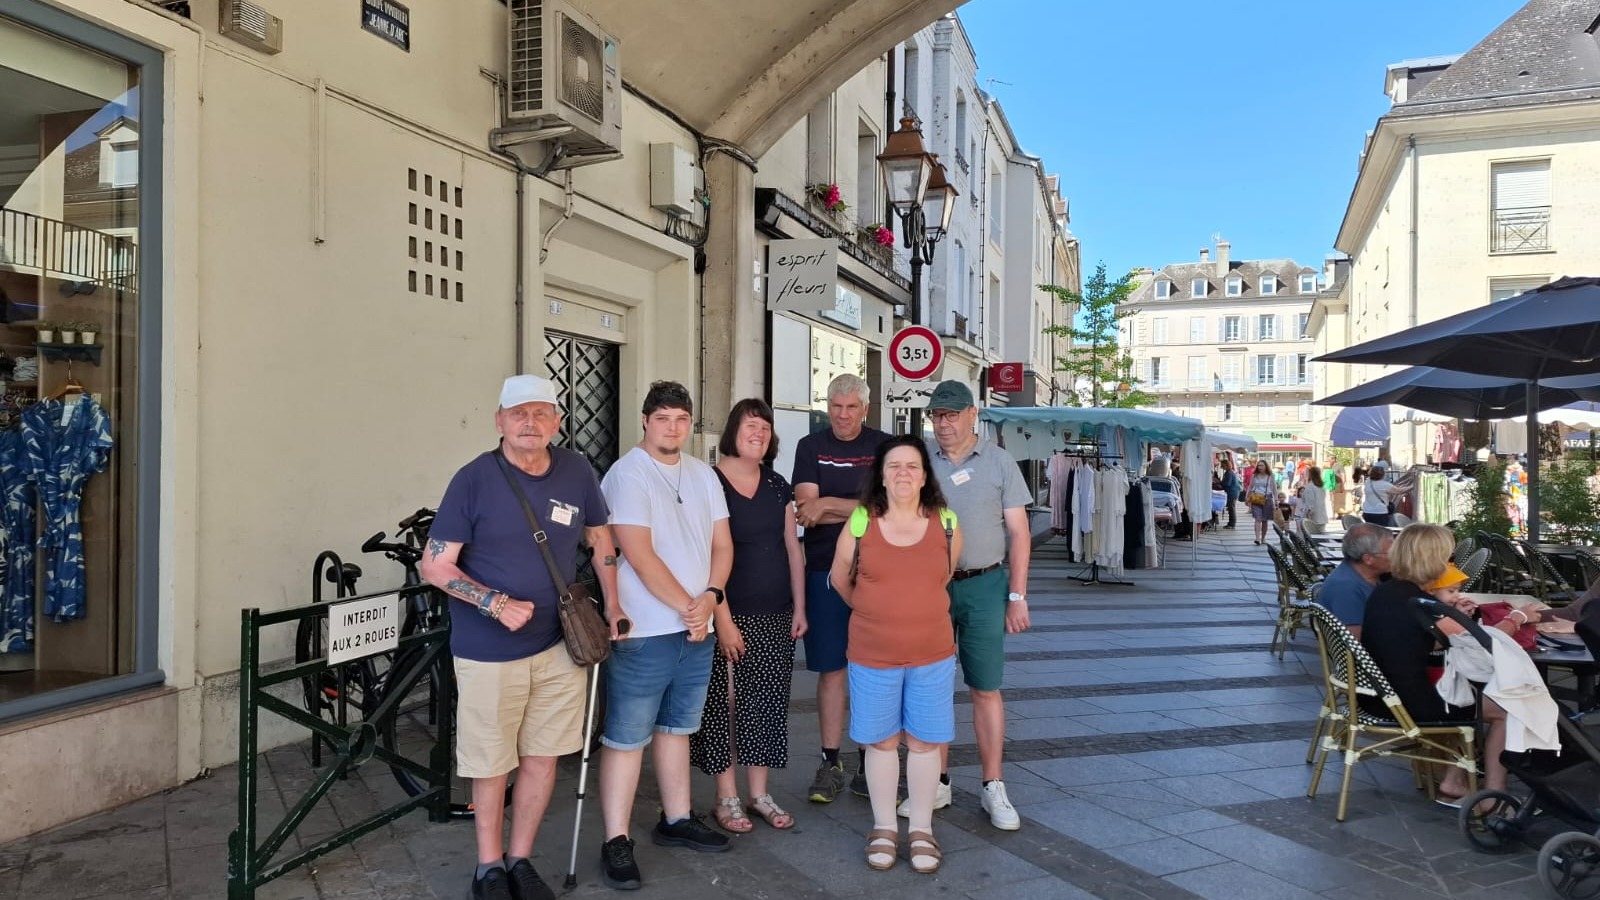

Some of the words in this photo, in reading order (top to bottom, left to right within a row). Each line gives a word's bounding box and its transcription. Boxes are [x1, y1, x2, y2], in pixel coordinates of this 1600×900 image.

[776, 249, 828, 272] esprit
[776, 275, 827, 303] fleurs
[344, 607, 387, 626] INTERDIT
[332, 637, 352, 653] AUX
[354, 634, 361, 647] 2
[365, 627, 396, 645] ROUES
